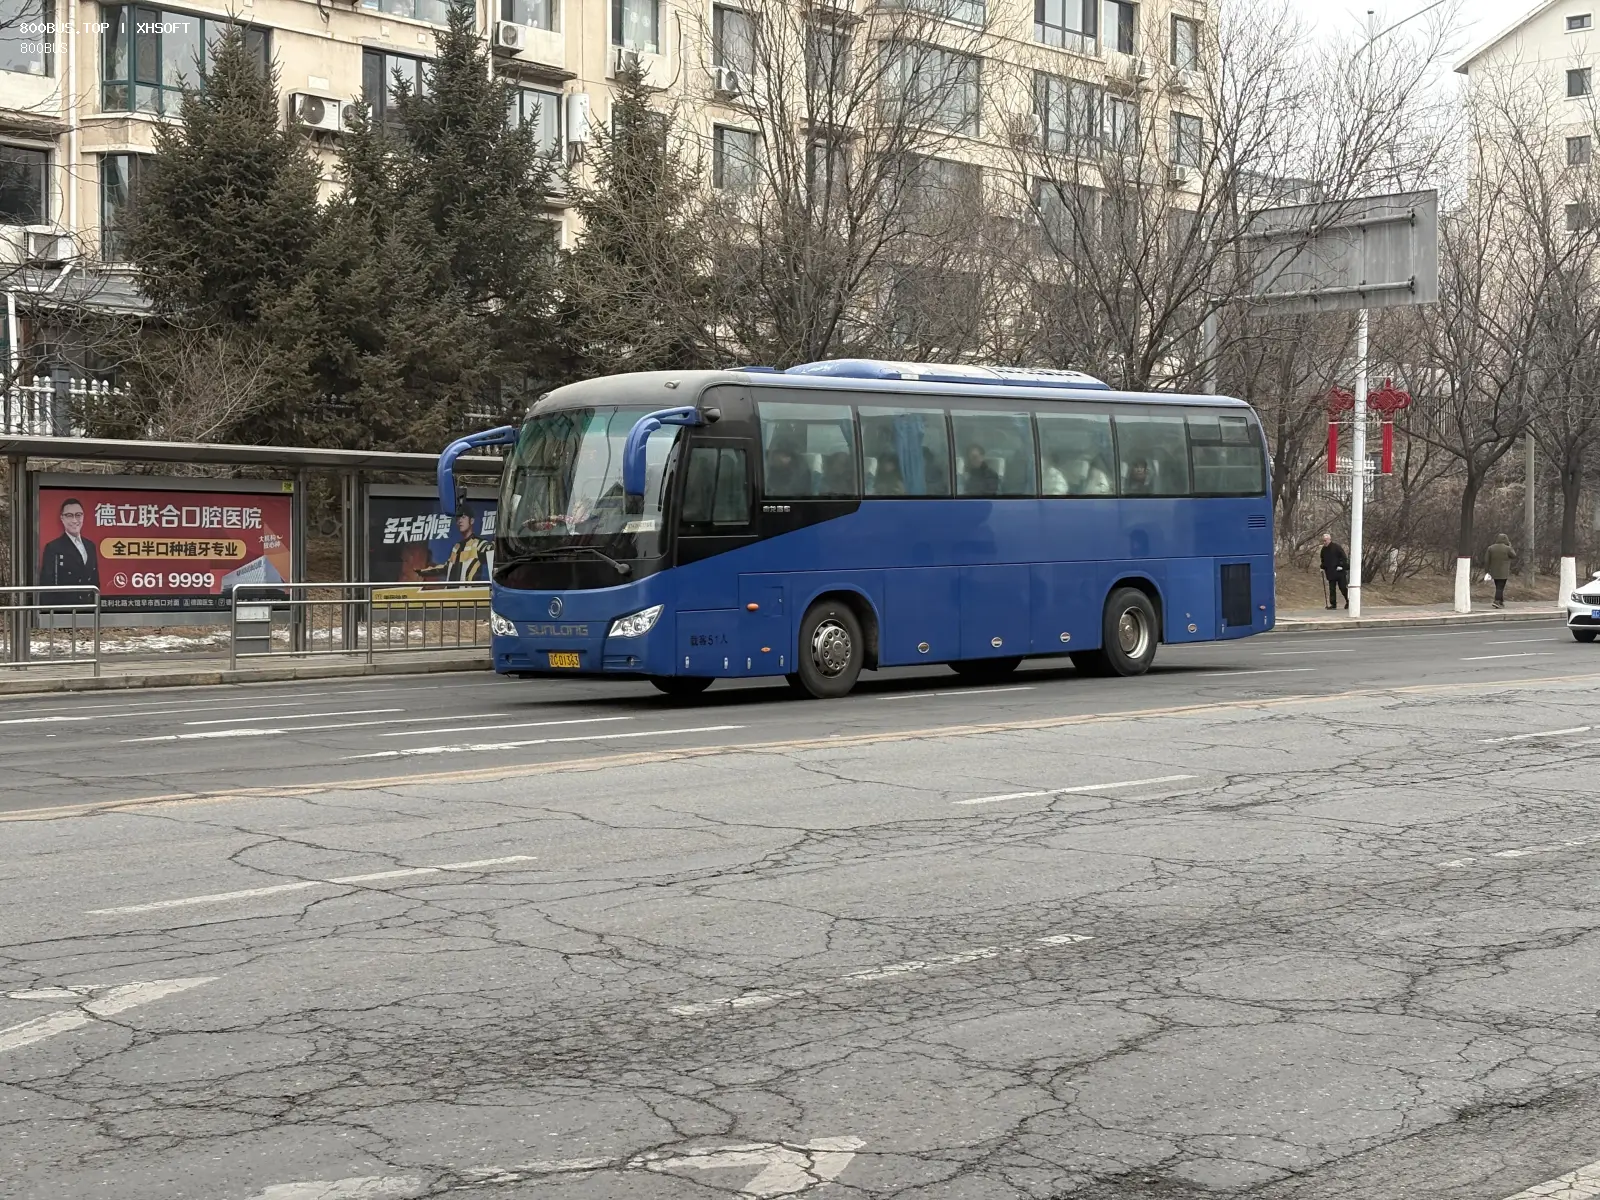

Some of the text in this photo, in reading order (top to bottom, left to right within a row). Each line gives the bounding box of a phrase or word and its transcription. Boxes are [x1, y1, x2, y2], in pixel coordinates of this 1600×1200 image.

[95, 502, 262, 529] 德立联合口腔医院
[383, 514, 452, 544] 冬天点外卖
[112, 540, 238, 557] 全口半口种植牙专业
[131, 572, 215, 588] 661 9999
[526, 624, 589, 636] SUNLONG
